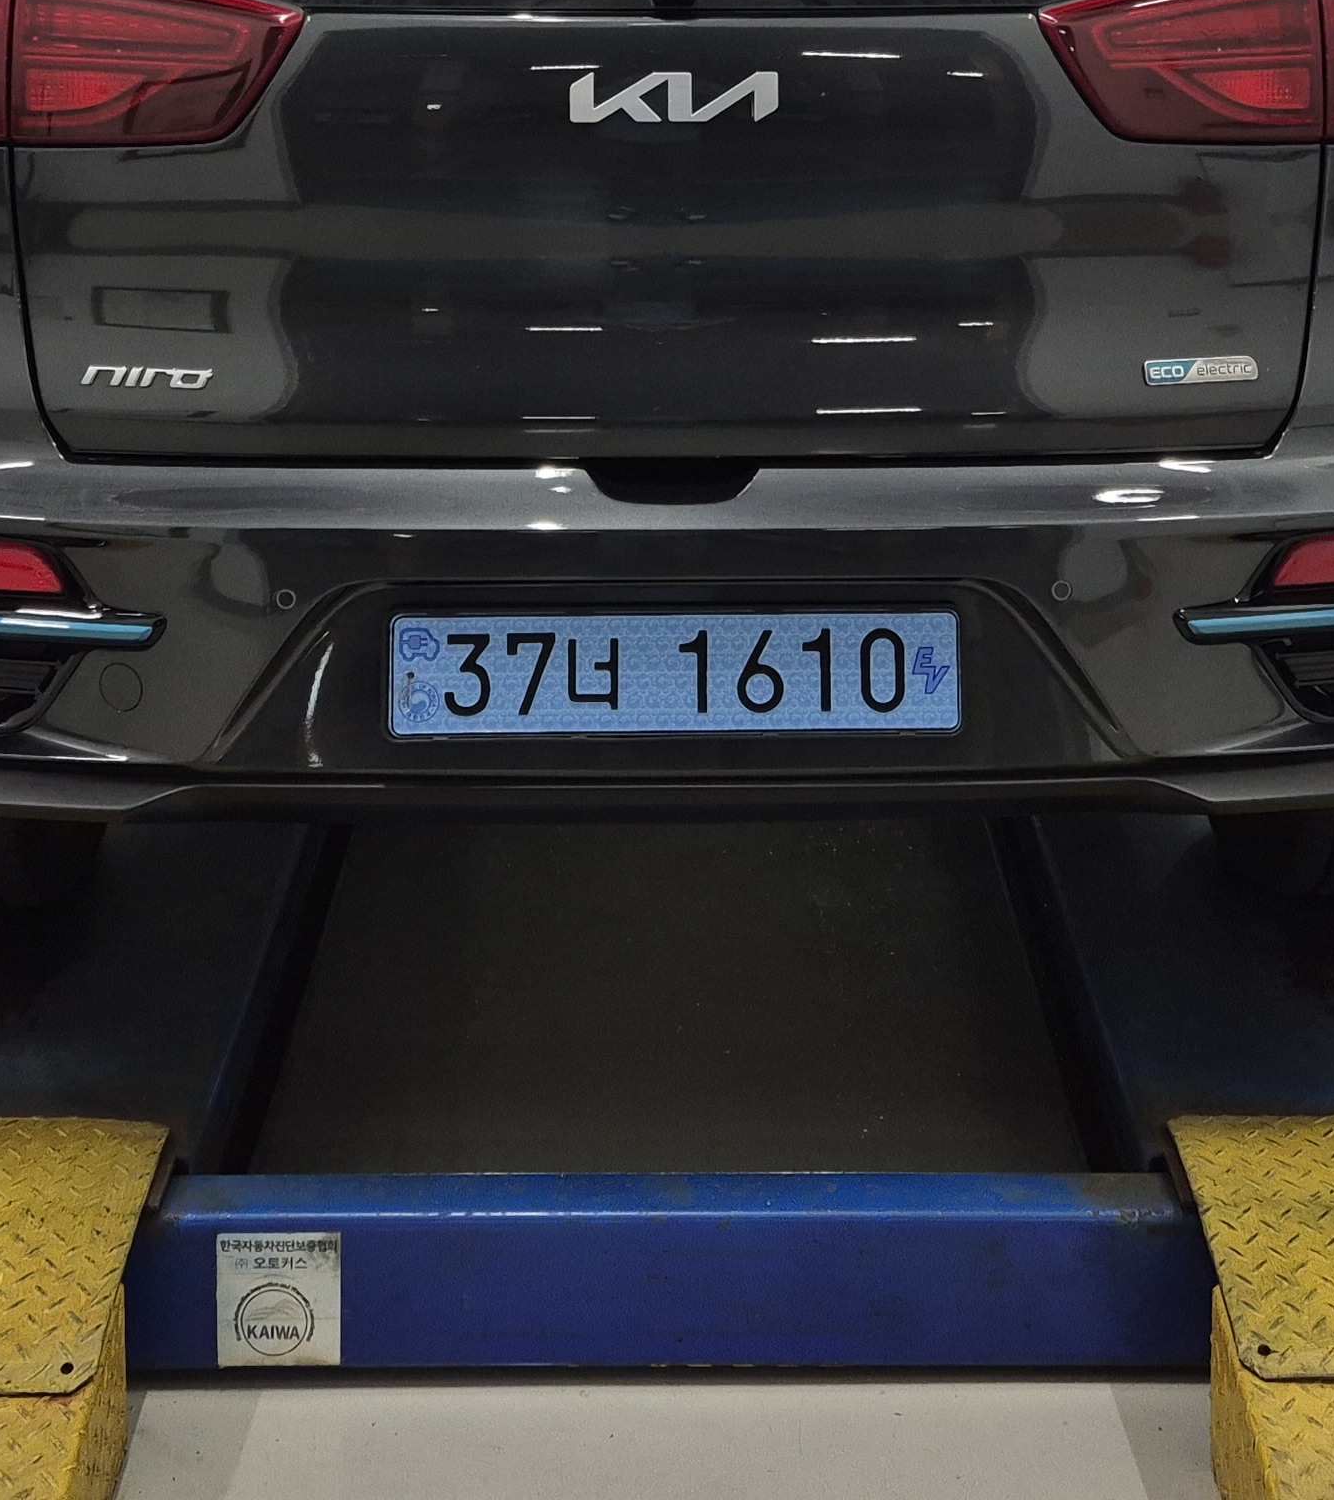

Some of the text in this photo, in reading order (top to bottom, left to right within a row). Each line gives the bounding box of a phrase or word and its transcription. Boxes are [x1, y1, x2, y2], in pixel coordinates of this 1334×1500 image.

[569, 72, 779, 123] KIA
[1149, 361, 1253, 379] ECO electric
[443, 632, 619, 717] 37너
[678, 627, 906, 714] 1610
[912, 646, 951, 695] EV
[220, 1240, 338, 1253] 한국자동차진단보증협회
[247, 1325, 300, 1340] KAIWA
